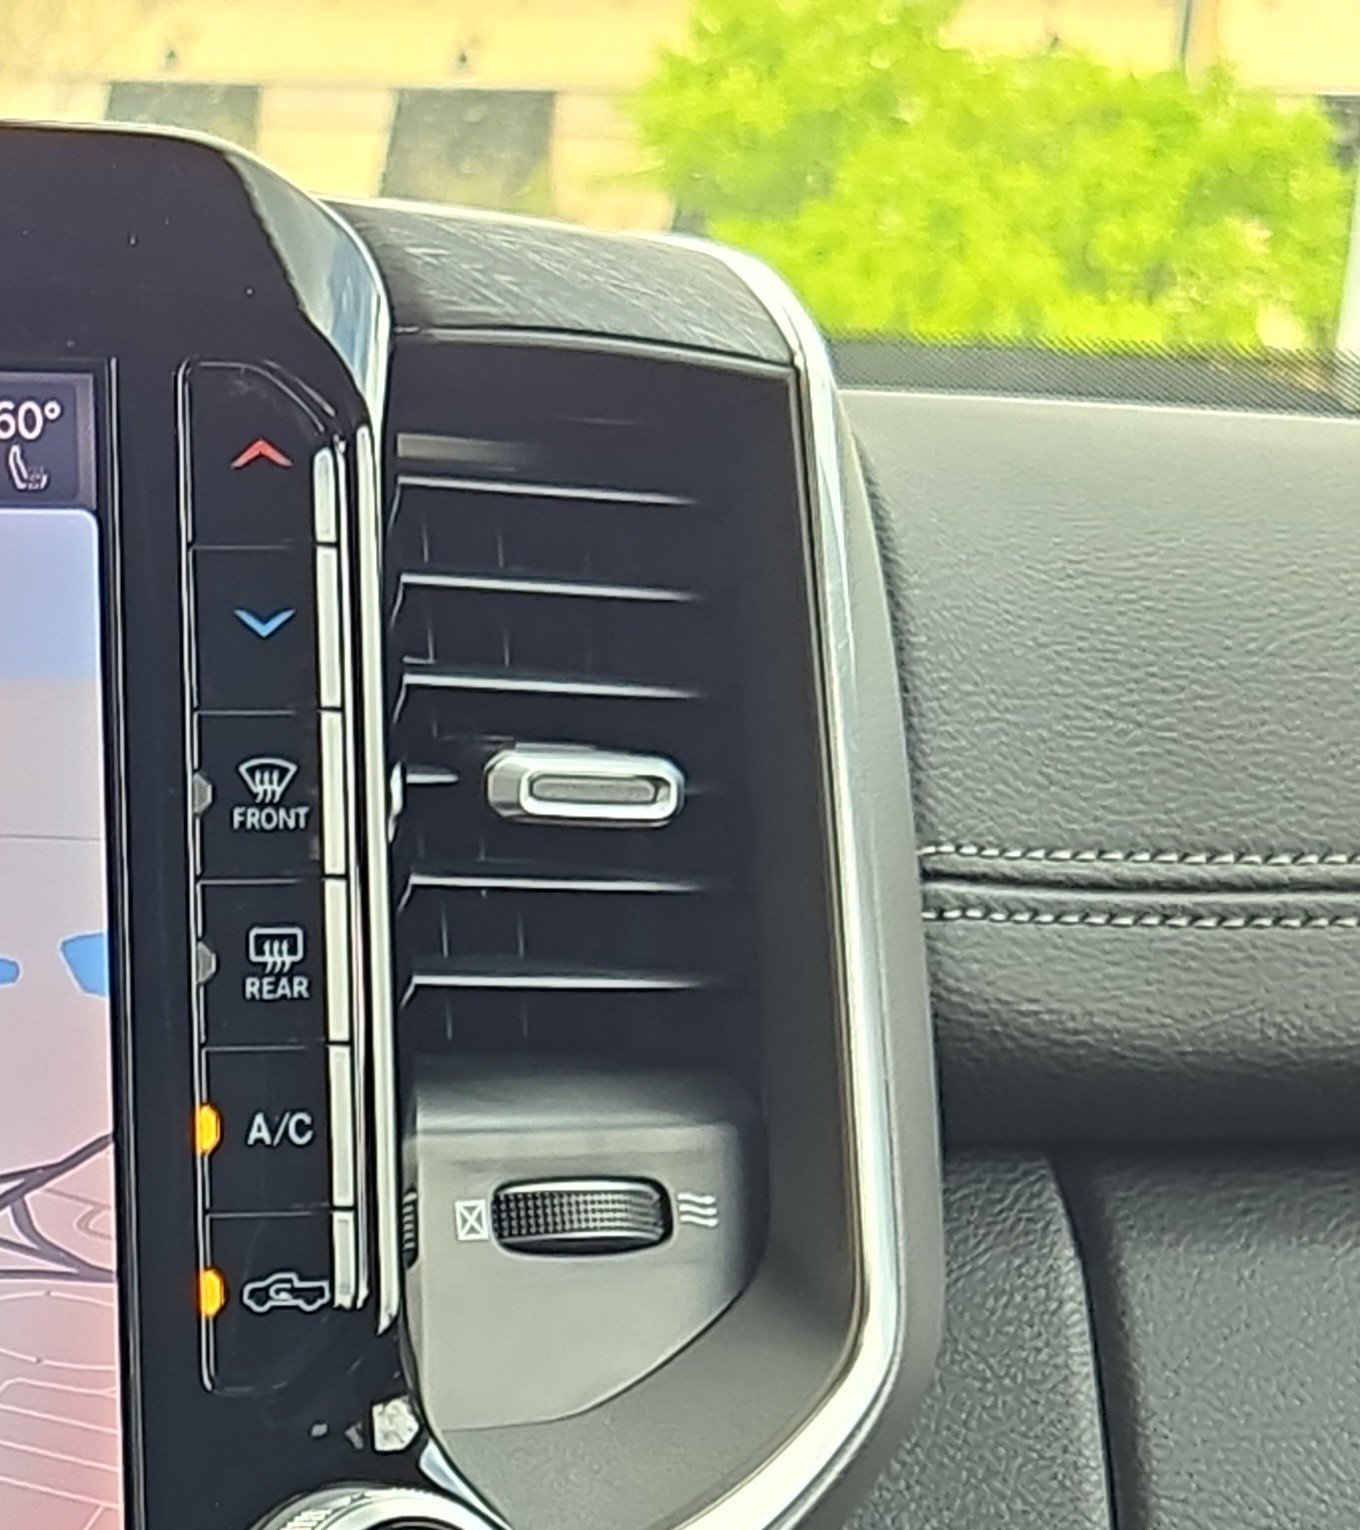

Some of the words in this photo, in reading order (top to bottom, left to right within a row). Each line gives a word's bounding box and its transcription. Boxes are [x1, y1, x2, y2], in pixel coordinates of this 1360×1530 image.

[233, 806, 310, 830] FRONT
[244, 975, 309, 1000] REAR
[246, 1113, 314, 1146] A/C
